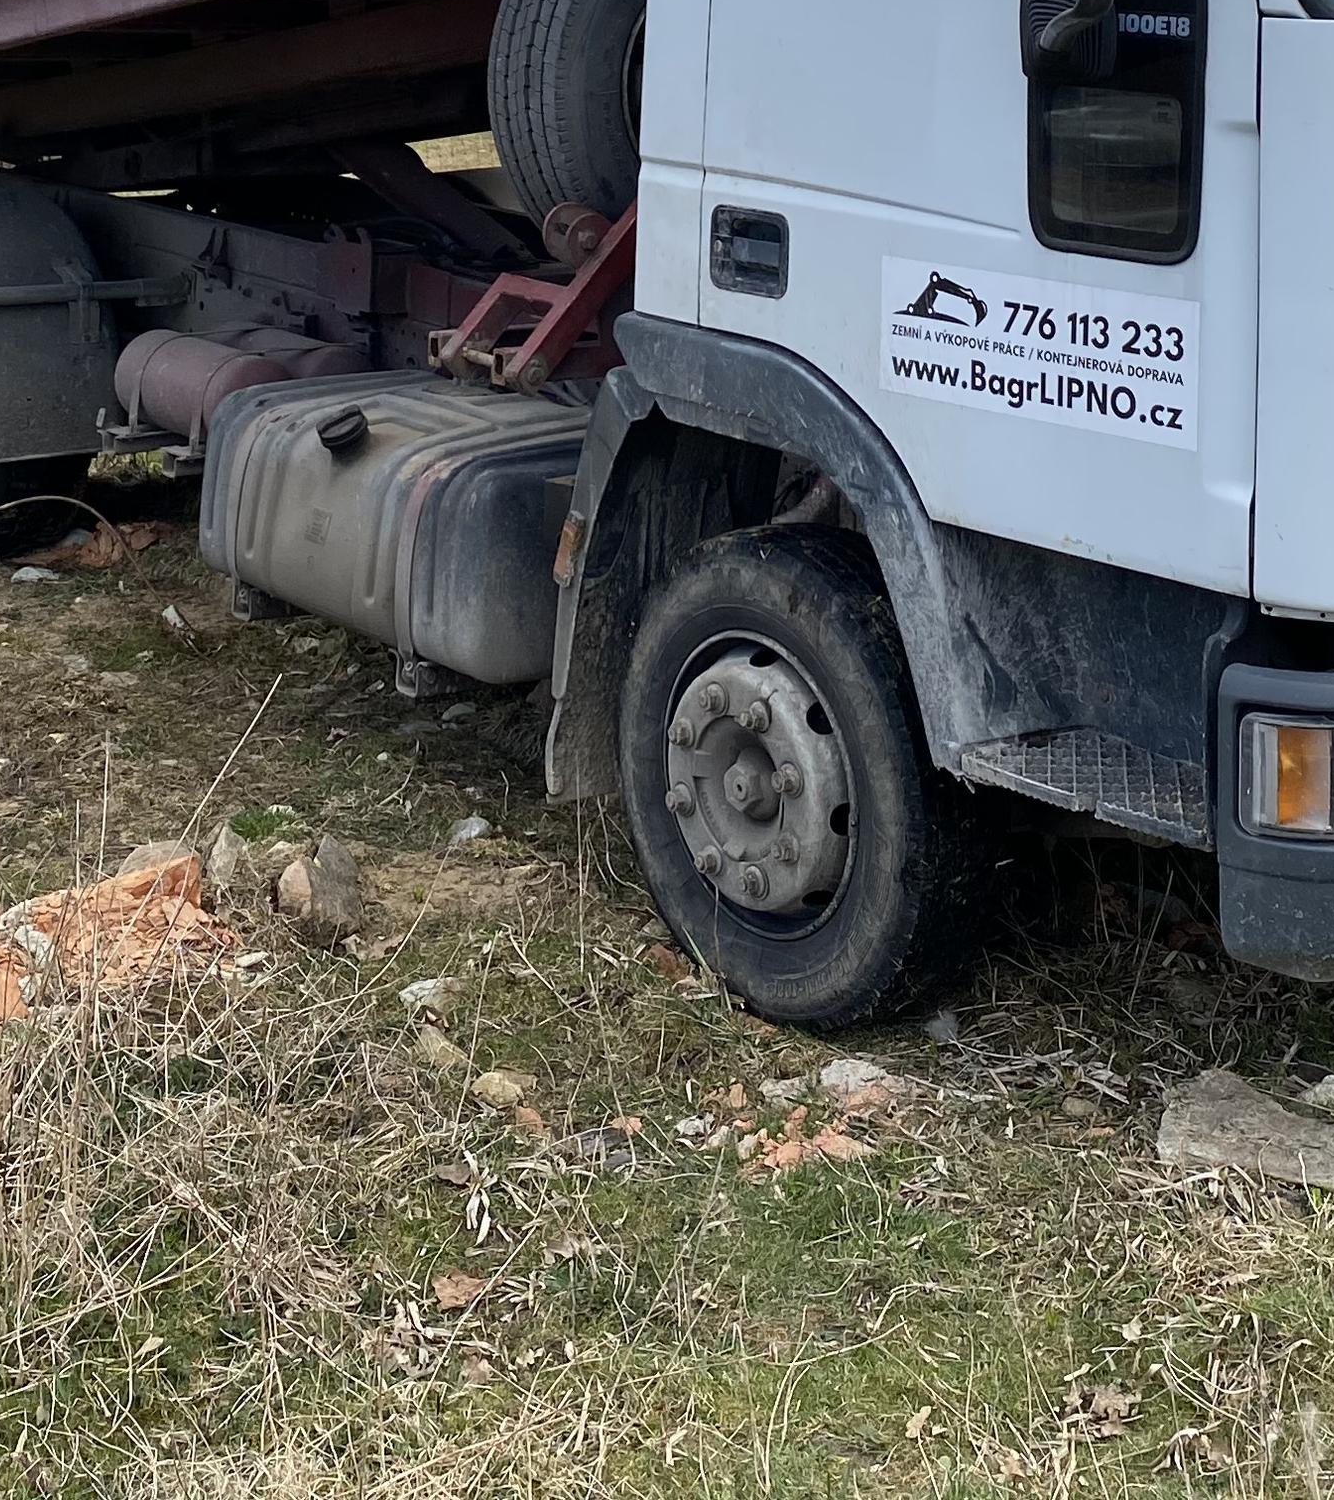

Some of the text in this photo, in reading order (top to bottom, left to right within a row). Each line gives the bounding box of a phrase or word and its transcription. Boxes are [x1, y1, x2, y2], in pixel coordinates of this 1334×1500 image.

[1118, 13, 1191, 37] 100E18
[892, 324, 922, 340] ZEMNÍ
[924, 330, 932, 341] A
[935, 329, 990, 351] VÝKOPOVÉ
[993, 341, 1025, 357] PRÁCE
[1037, 349, 1124, 375] KONTEJNEROVÁ
[1128, 365, 1184, 386] DOPRAVA
[1003, 300, 1184, 361] 776 113 233
[892, 356, 1183, 430] www.BagrLIPNO.cz
